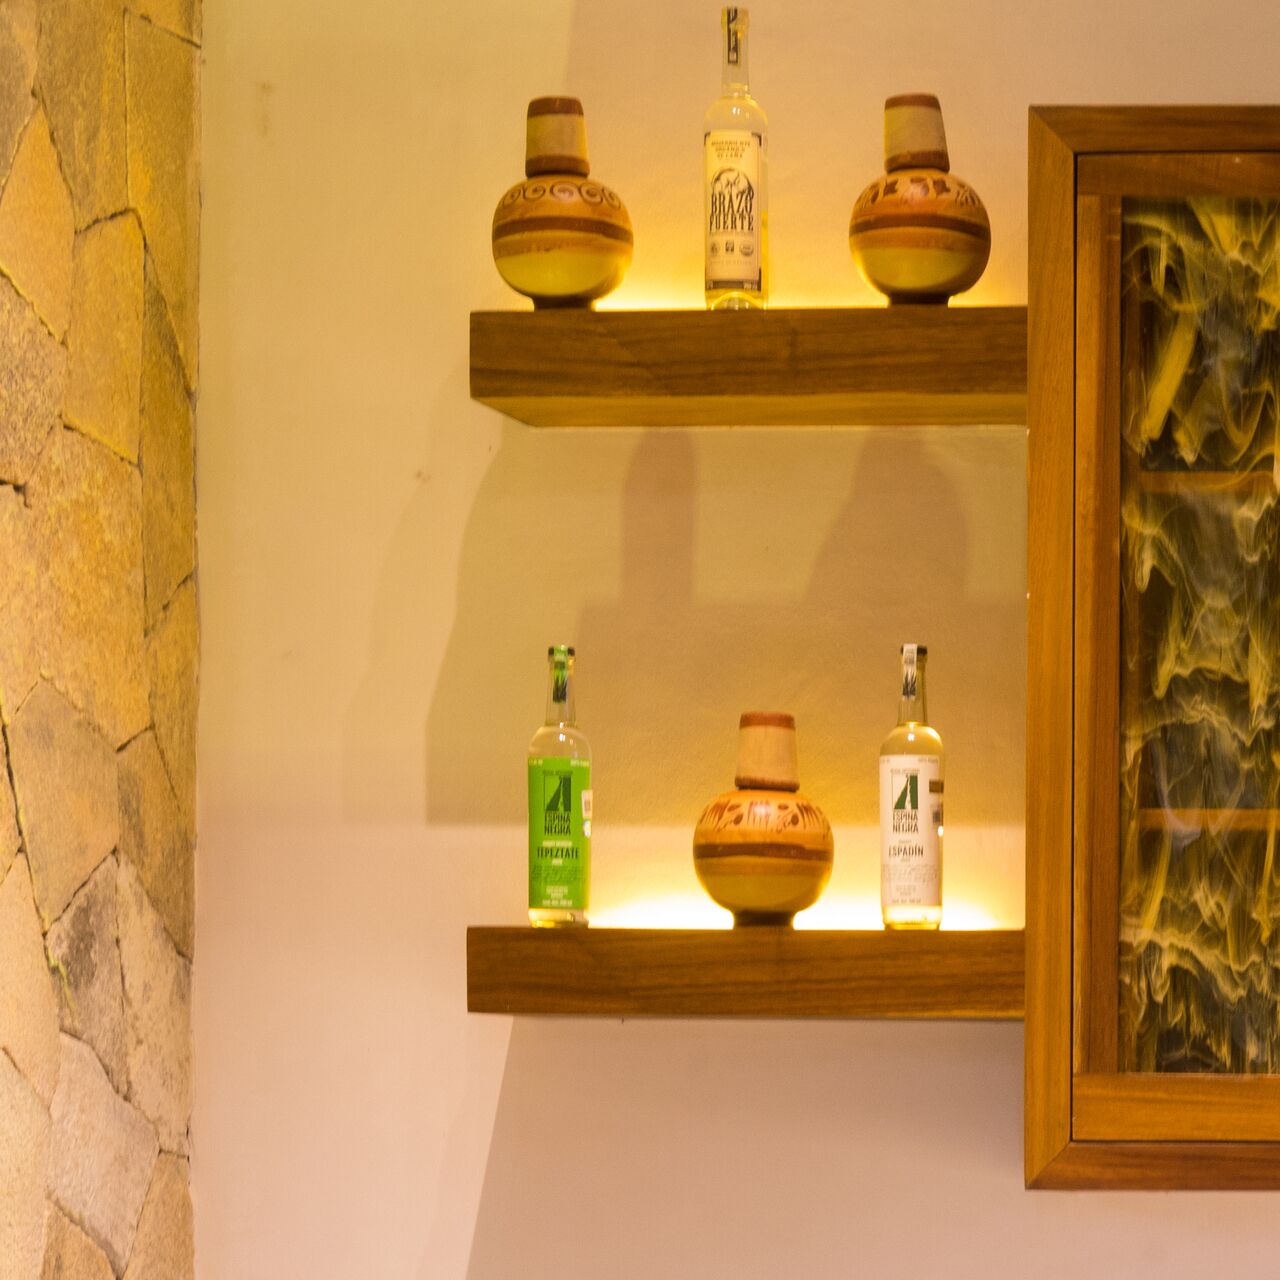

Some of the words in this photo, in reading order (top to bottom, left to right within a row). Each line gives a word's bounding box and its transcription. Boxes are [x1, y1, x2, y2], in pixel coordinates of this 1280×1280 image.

[711, 189, 754, 216] BRAZO
[709, 211, 754, 232] FUERTE
[544, 811, 571, 822] ESPINA
[893, 810, 919, 821] ESPINA
[544, 823, 571, 835] NEGRA
[892, 822, 919, 833] NEGRA
[537, 847, 579, 859] TEPEZTATE
[888, 845, 924, 857] ESPADÍN
